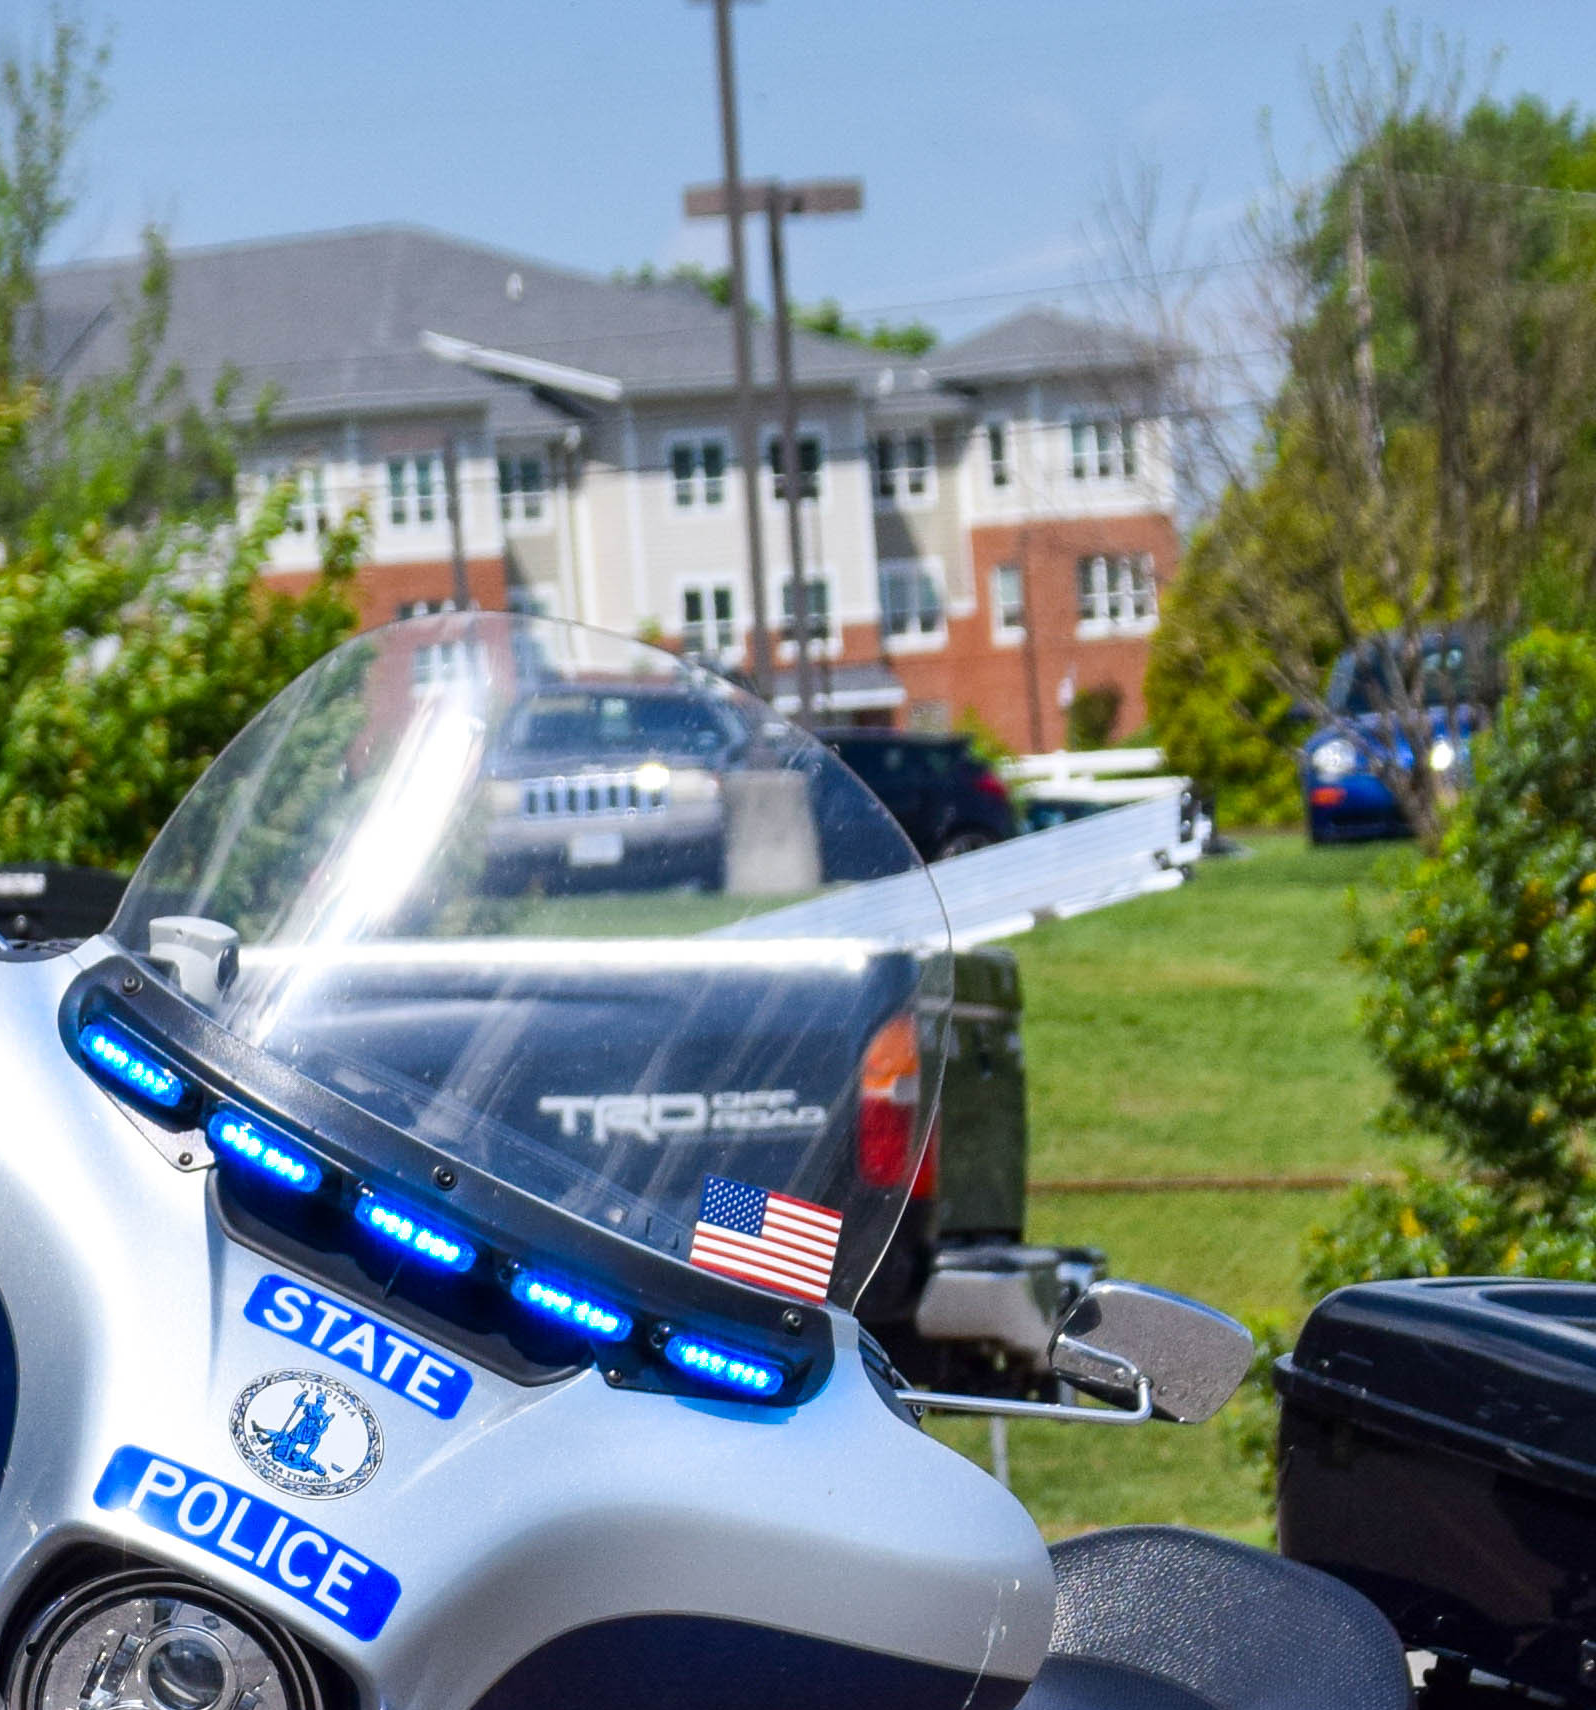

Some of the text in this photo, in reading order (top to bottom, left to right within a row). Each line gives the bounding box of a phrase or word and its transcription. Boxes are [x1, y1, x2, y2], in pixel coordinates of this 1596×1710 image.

[539, 1093, 708, 1145] TRD
[262, 1286, 455, 1410] STATE
[127, 1458, 370, 1617] POLICE
